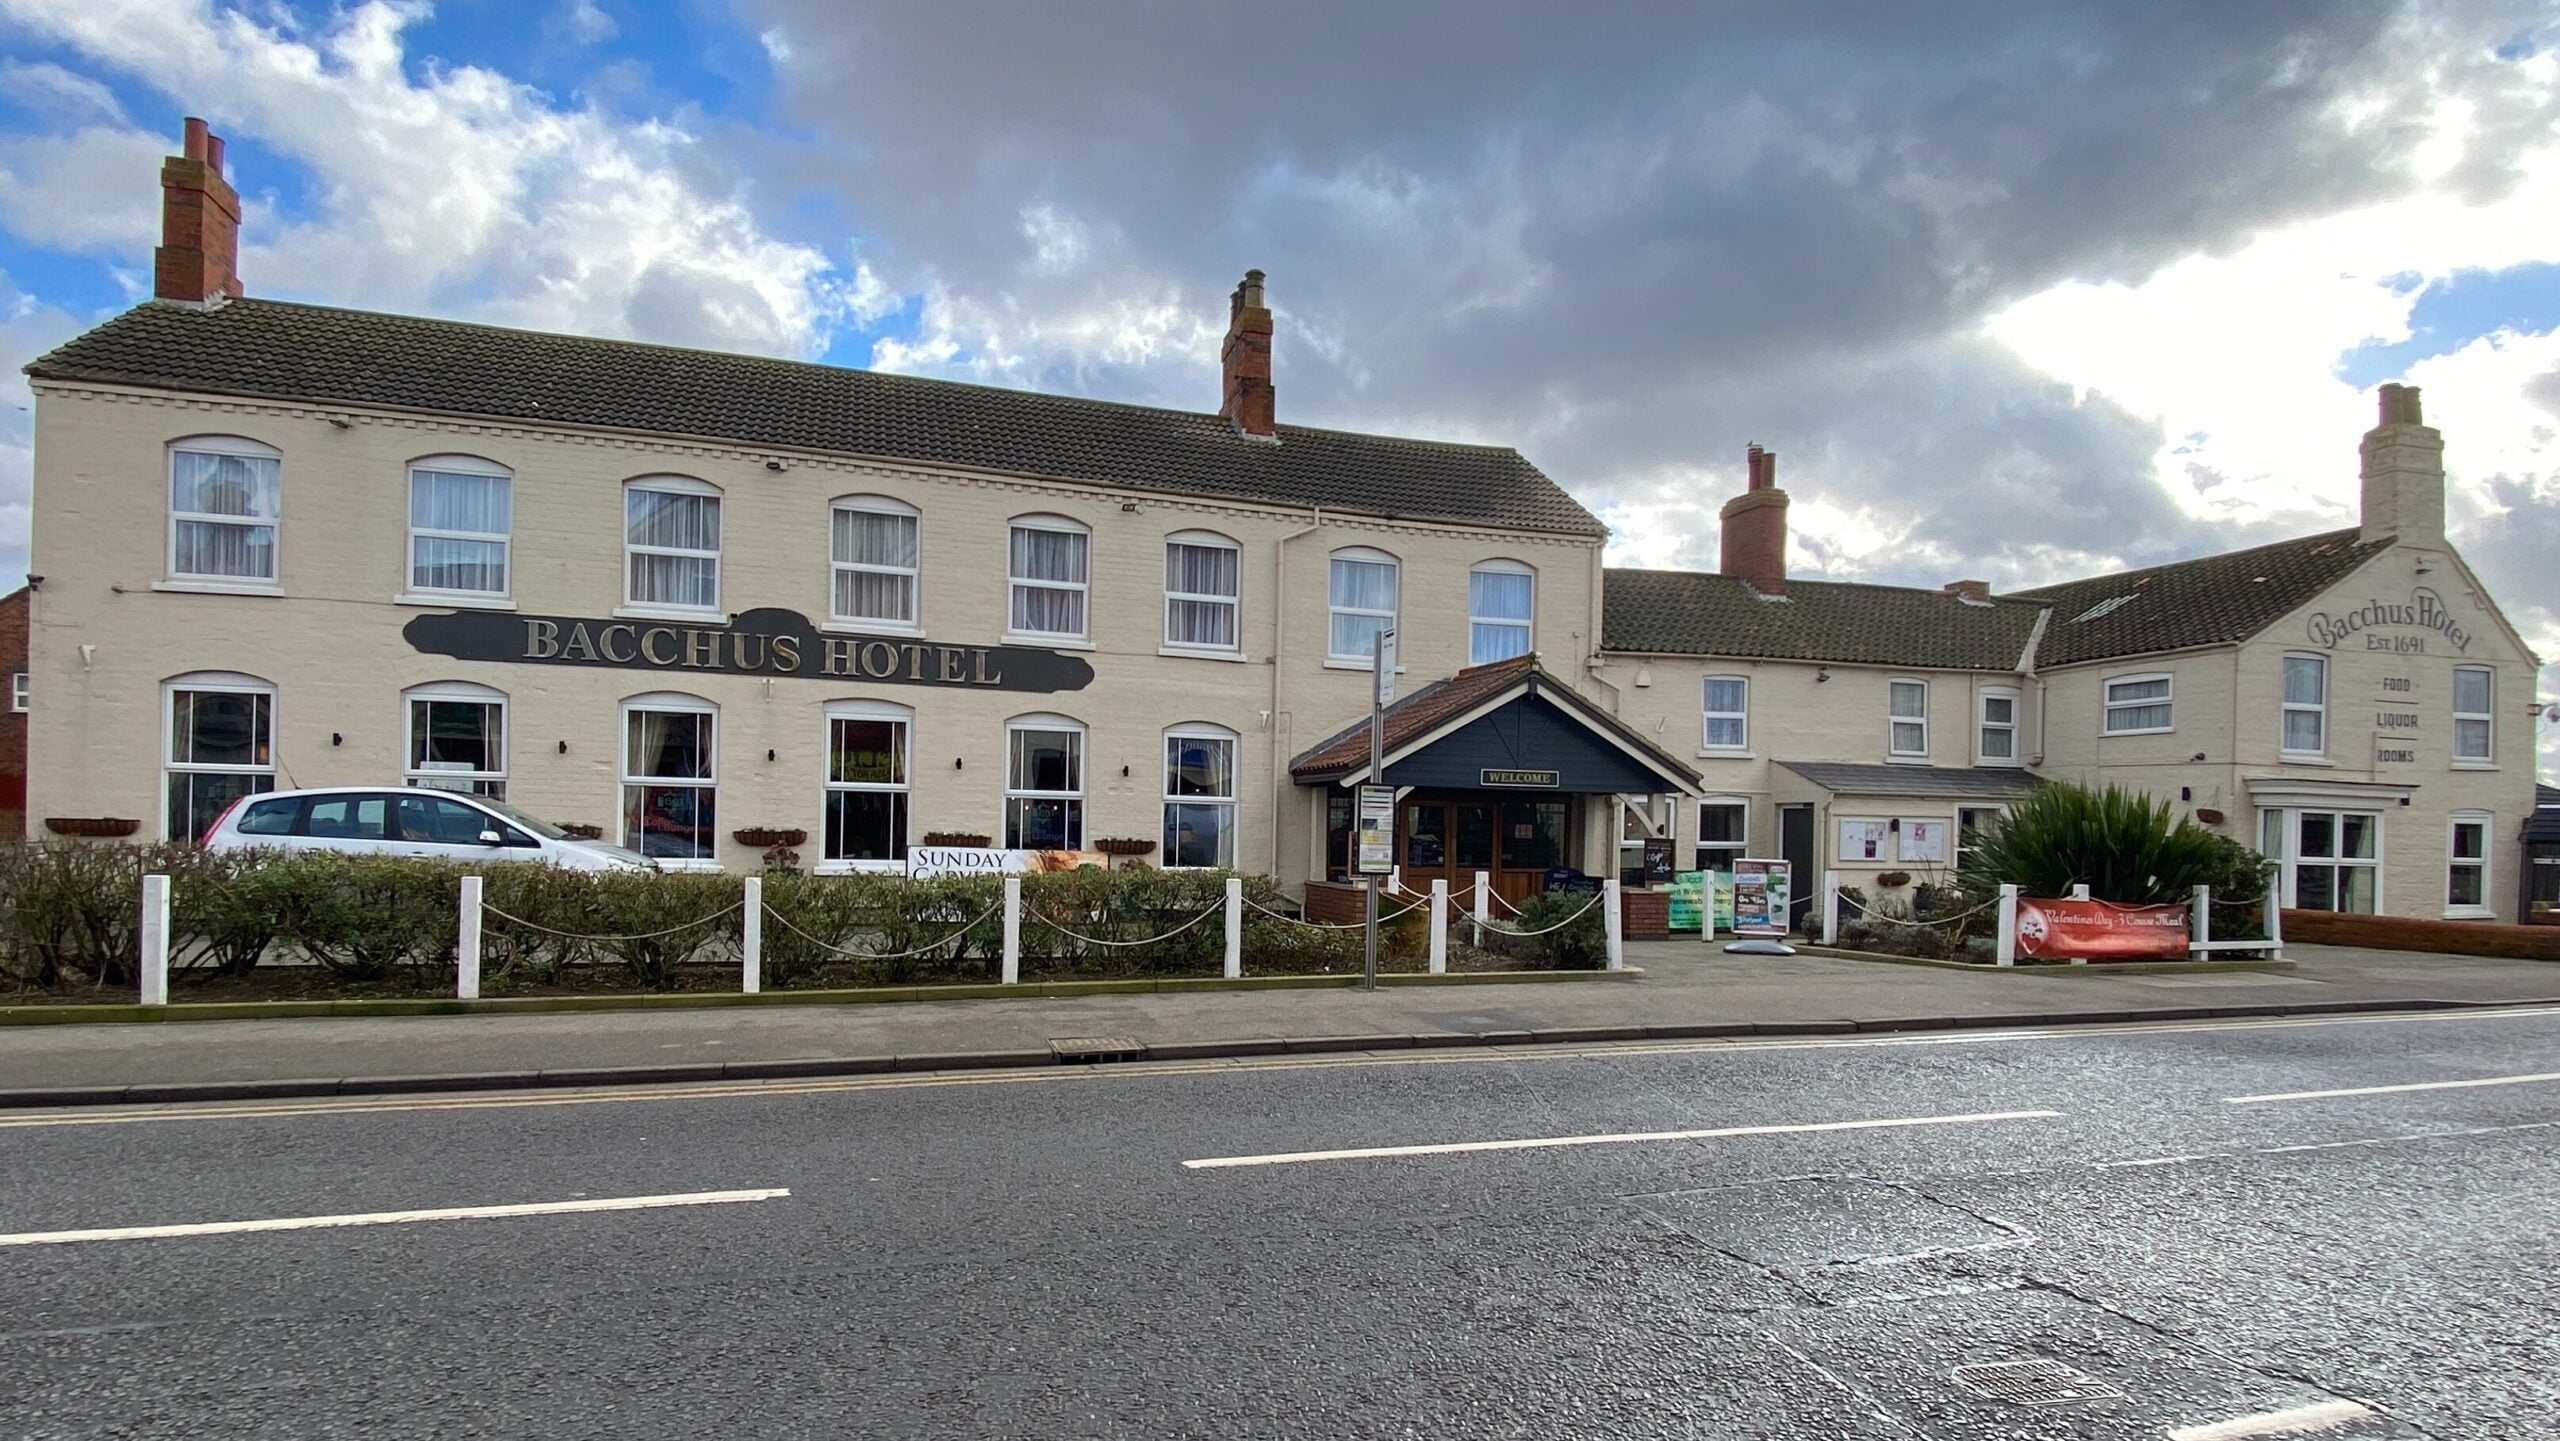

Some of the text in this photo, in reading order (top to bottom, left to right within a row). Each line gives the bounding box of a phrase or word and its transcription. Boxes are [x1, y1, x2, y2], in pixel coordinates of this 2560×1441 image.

[2307, 587, 2472, 653] Bacchus Hotel
[522, 619, 1003, 685] BACCHUS HOTEL
[2394, 636, 2425, 653] 1691
[2383, 677, 2410, 692] FOOD
[2376, 712, 2418, 729] LIQUOR
[2377, 749, 2414, 763] ROOMS
[1488, 772, 1551, 784] WELCOME
[917, 848, 1006, 868] SUNDAY
[2094, 911, 2113, 930] Day
[2119, 912, 2125, 927] 3
[2126, 912, 2154, 926] Course
[2155, 912, 2185, 926] Meal
